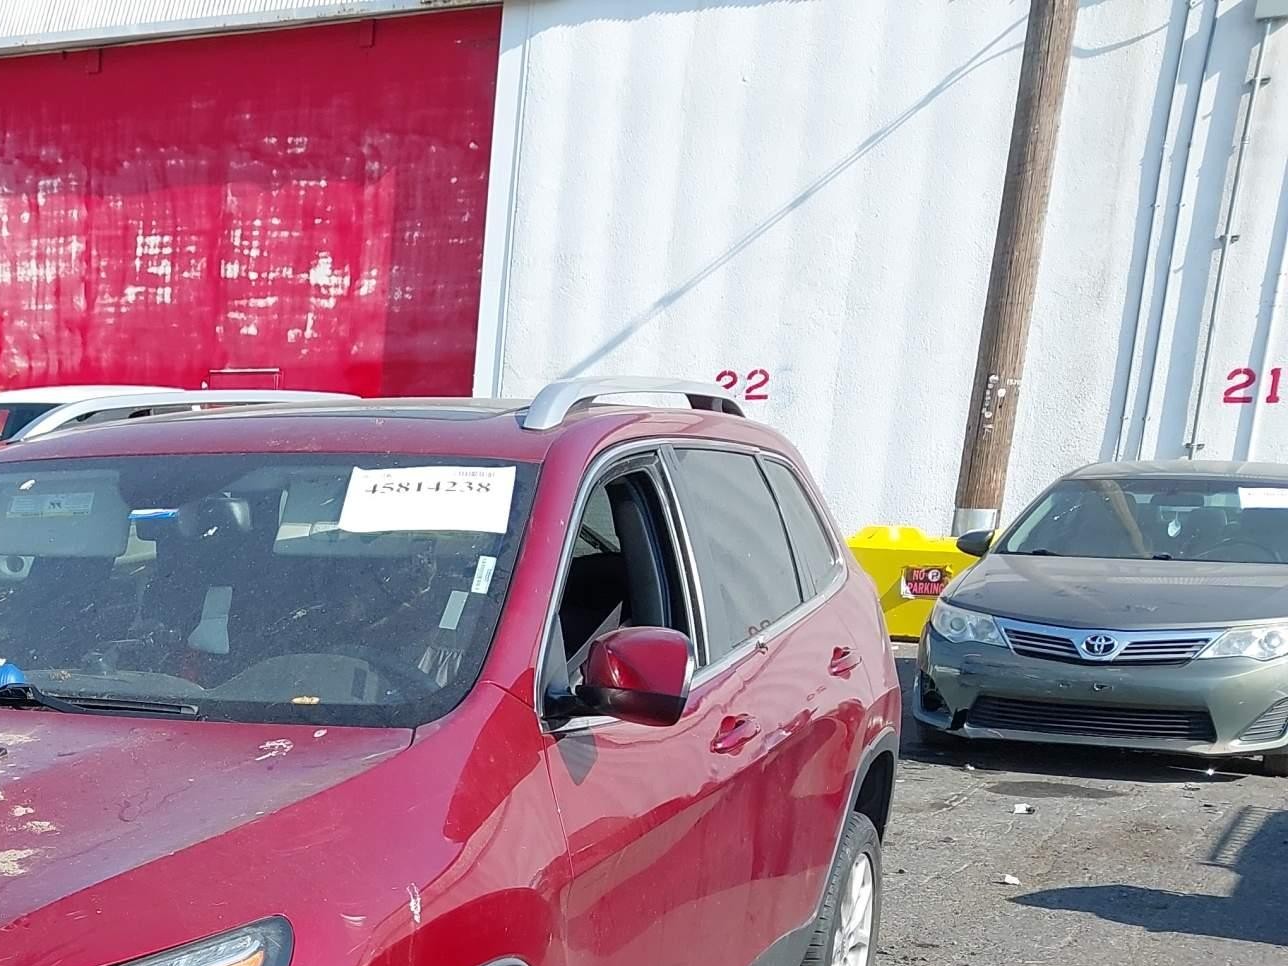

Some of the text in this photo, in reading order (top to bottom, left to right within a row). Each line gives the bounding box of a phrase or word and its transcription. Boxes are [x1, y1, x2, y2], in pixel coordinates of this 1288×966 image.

[715, 368, 770, 400] 22
[1223, 367, 1282, 403] 21
[364, 480, 492, 494] 45814238
[912, 569, 926, 580] NO
